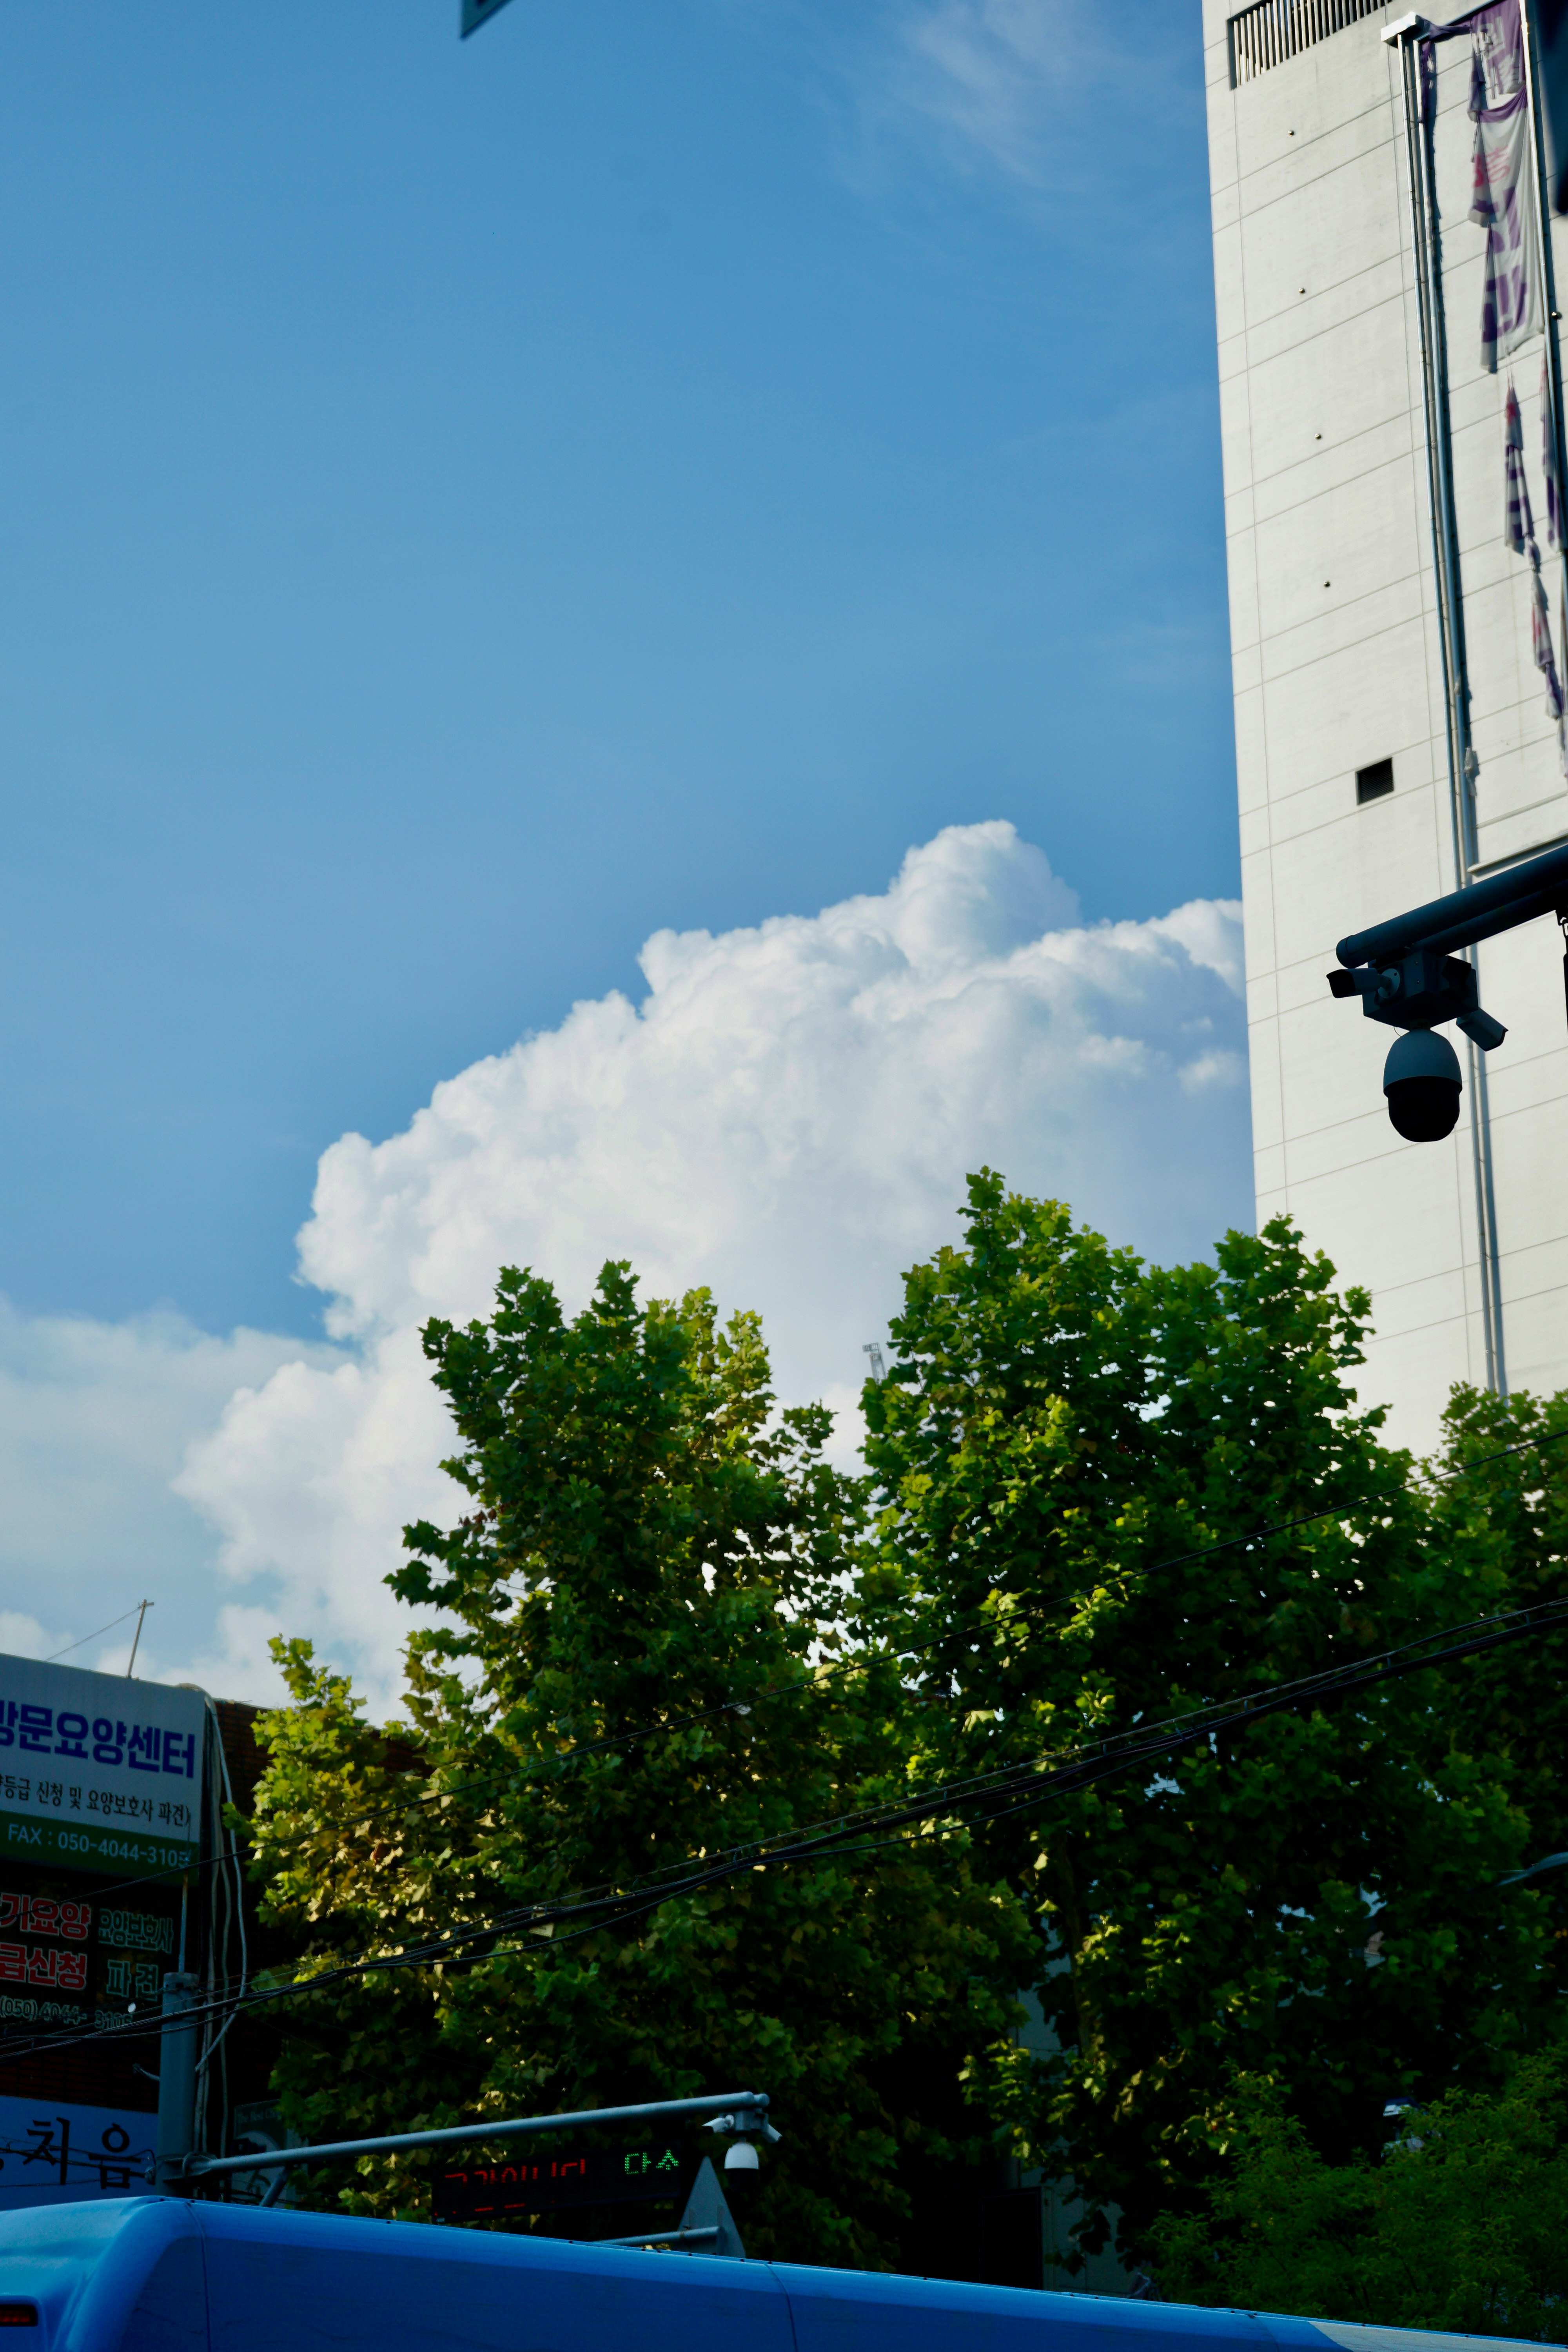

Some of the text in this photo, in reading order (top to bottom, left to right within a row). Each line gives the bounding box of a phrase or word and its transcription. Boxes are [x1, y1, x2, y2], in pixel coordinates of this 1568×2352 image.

[0, 1773, 191, 1827] 등급 신청 및 요양보호사 파견)
[8, 1823, 42, 1846] FAX
[98, 1907, 174, 1955] 요양보호사
